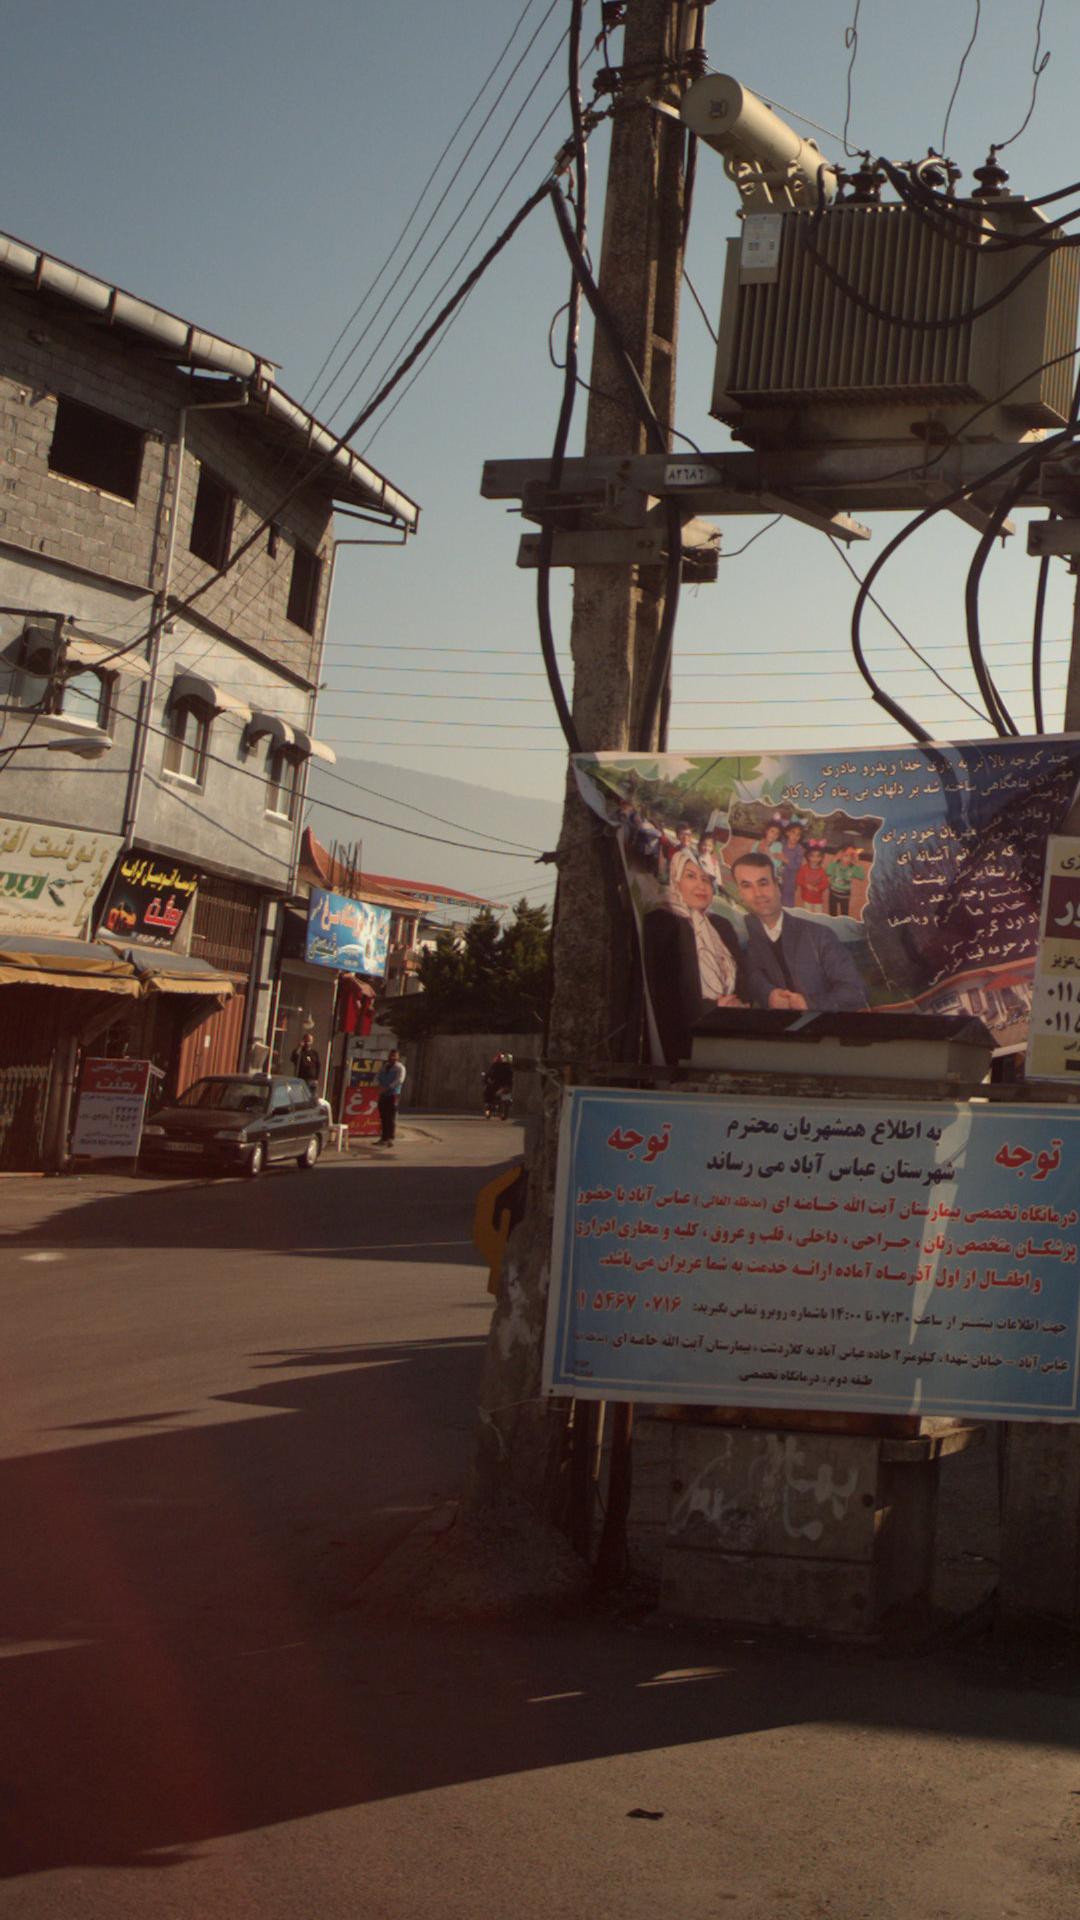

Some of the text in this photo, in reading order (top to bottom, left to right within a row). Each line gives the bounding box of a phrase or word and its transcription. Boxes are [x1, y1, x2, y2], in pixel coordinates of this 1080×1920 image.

[822, 761, 857, 778] مادری
[899, 759, 923, 772] خدا
[831, 786, 850, 801] پناه
[873, 781, 904, 799] دلهای
[907, 785, 920, 799] بر
[922, 779, 942, 794] شد
[854, 788, 869, 802] بی
[881, 828, 907, 845] برای
[910, 827, 936, 844] خود
[896, 850, 912, 865] ای
[727, 1116, 942, 1147] به اطلاع همشهریان محترم
[607, 1122, 672, 1163] توجه
[994, 1138, 1062, 1181] توجه
[706, 1151, 956, 1187] شهرستان عباس آباد می رساند
[615, 1186, 626, 1204] با
[628, 1185, 654, 1204] آباد
[655, 1189, 691, 1208] عباس
[771, 1195, 791, 1214] ای
[843, 1198, 866, 1215] الله
[869, 1198, 897, 1217] آیت
[899, 1200, 961, 1222] بیمارستان
[964, 1206, 1018, 1226] تخصصی
[1020, 1205, 1078, 1229] درمانگاه
[617, 1219, 659, 1239] مجاری
[662, 1226, 670, 1240] و
[673, 1221, 700, 1238] کلیه
[748, 1231, 756, 1244] و
[758, 1229, 784, 1246] قلب
[956, 1241, 1012, 1258] متخصص
[1015, 1242, 1077, 1264] پزشکان
[635, 1258, 656, 1272] می
[657, 1254, 701, 1274] عزیزان
[706, 1255, 728, 1271] شما
[731, 1261, 744, 1275] به
[747, 1262, 788, 1276] خدمت
[835, 1262, 873, 1280] آماده
[935, 1266, 960, 1288] اول
[963, 1270, 977, 1290] از
[979, 1270, 1030, 1292] اطفال
[1032, 1278, 1041, 1295] و
[592, 1290, 637, 1311] ۵۴۶۷
[643, 1295, 682, 1313] ۰۷۱۶
[730, 1304, 758, 1319] تماس
[760, 1306, 788, 1321] روبرو
[865, 1309, 873, 1322] تا
[913, 1313, 943, 1327] ساعت
[946, 1315, 957, 1331] از
[960, 1319, 993, 1332] بیشتر
[996, 1319, 1040, 1332] اطلاعات
[1041, 1321, 1068, 1334] جهت
[612, 1332, 628, 1349] ای
[661, 1334, 680, 1347] الله
[682, 1334, 705, 1350] آیت
[706, 1339, 752, 1355] بیمارستان
[805, 1347, 816, 1358] به
[817, 1343, 837, 1357] آباد
[838, 1347, 865, 1361] عباس
[869, 1349, 891, 1361] جاده
[902, 1352, 936, 1366] کیلومتر
[971, 1356, 1003, 1370] خیابان
[1018, 1357, 1039, 1370] آباد
[1040, 1359, 1068, 1373] عباس
[738, 1370, 778, 1382] تخصصی
[779, 1370, 821, 1388] درمانگاه
[850, 1374, 872, 1386] طبقه
